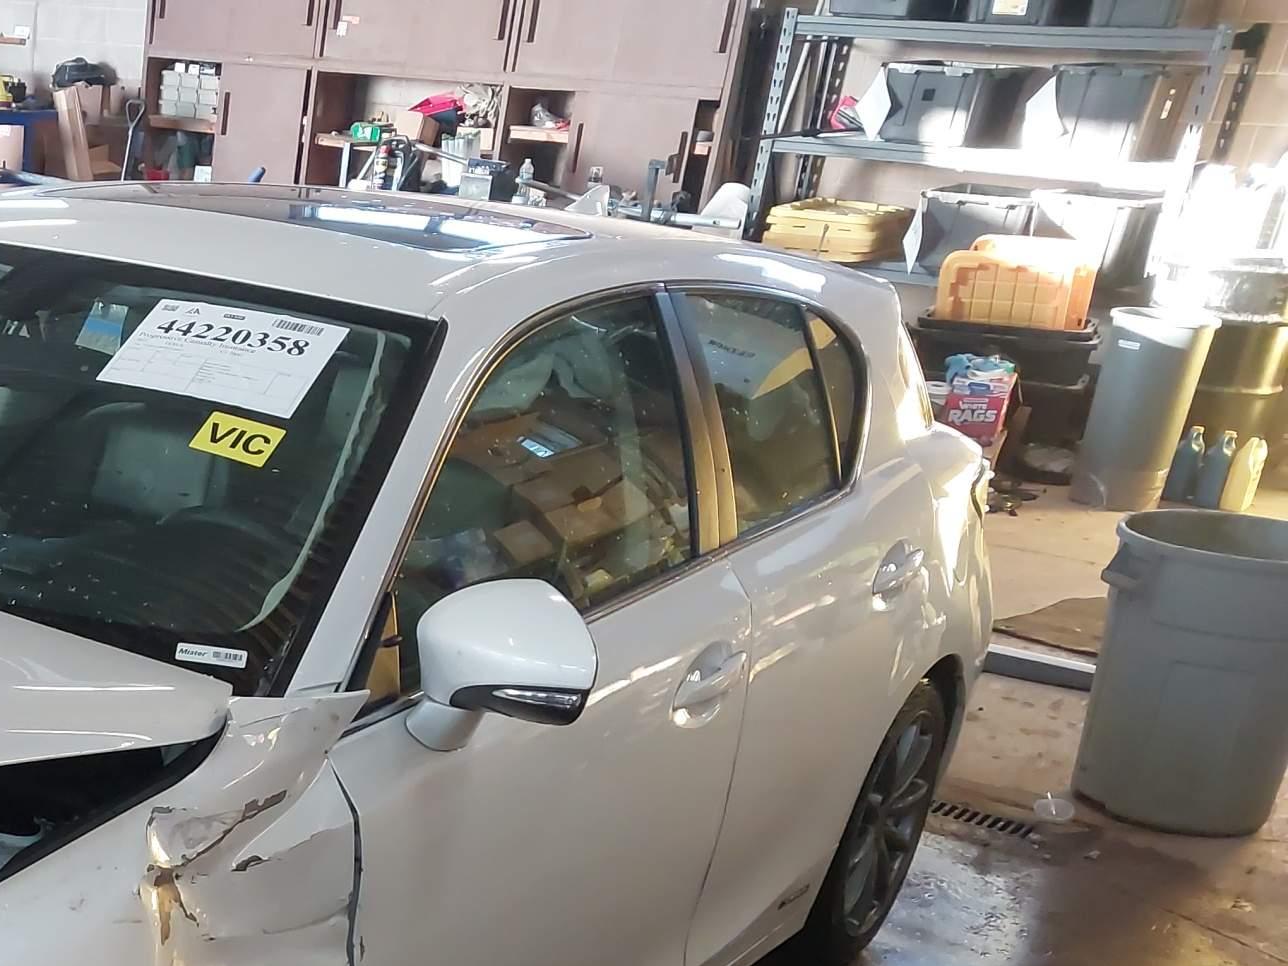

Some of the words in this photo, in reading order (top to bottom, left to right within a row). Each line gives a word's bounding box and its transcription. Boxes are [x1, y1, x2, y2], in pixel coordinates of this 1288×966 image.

[157, 319, 310, 357] 44220358
[948, 409, 998, 425] RAGS
[209, 422, 270, 456] VIC
[178, 648, 208, 657] Mister
